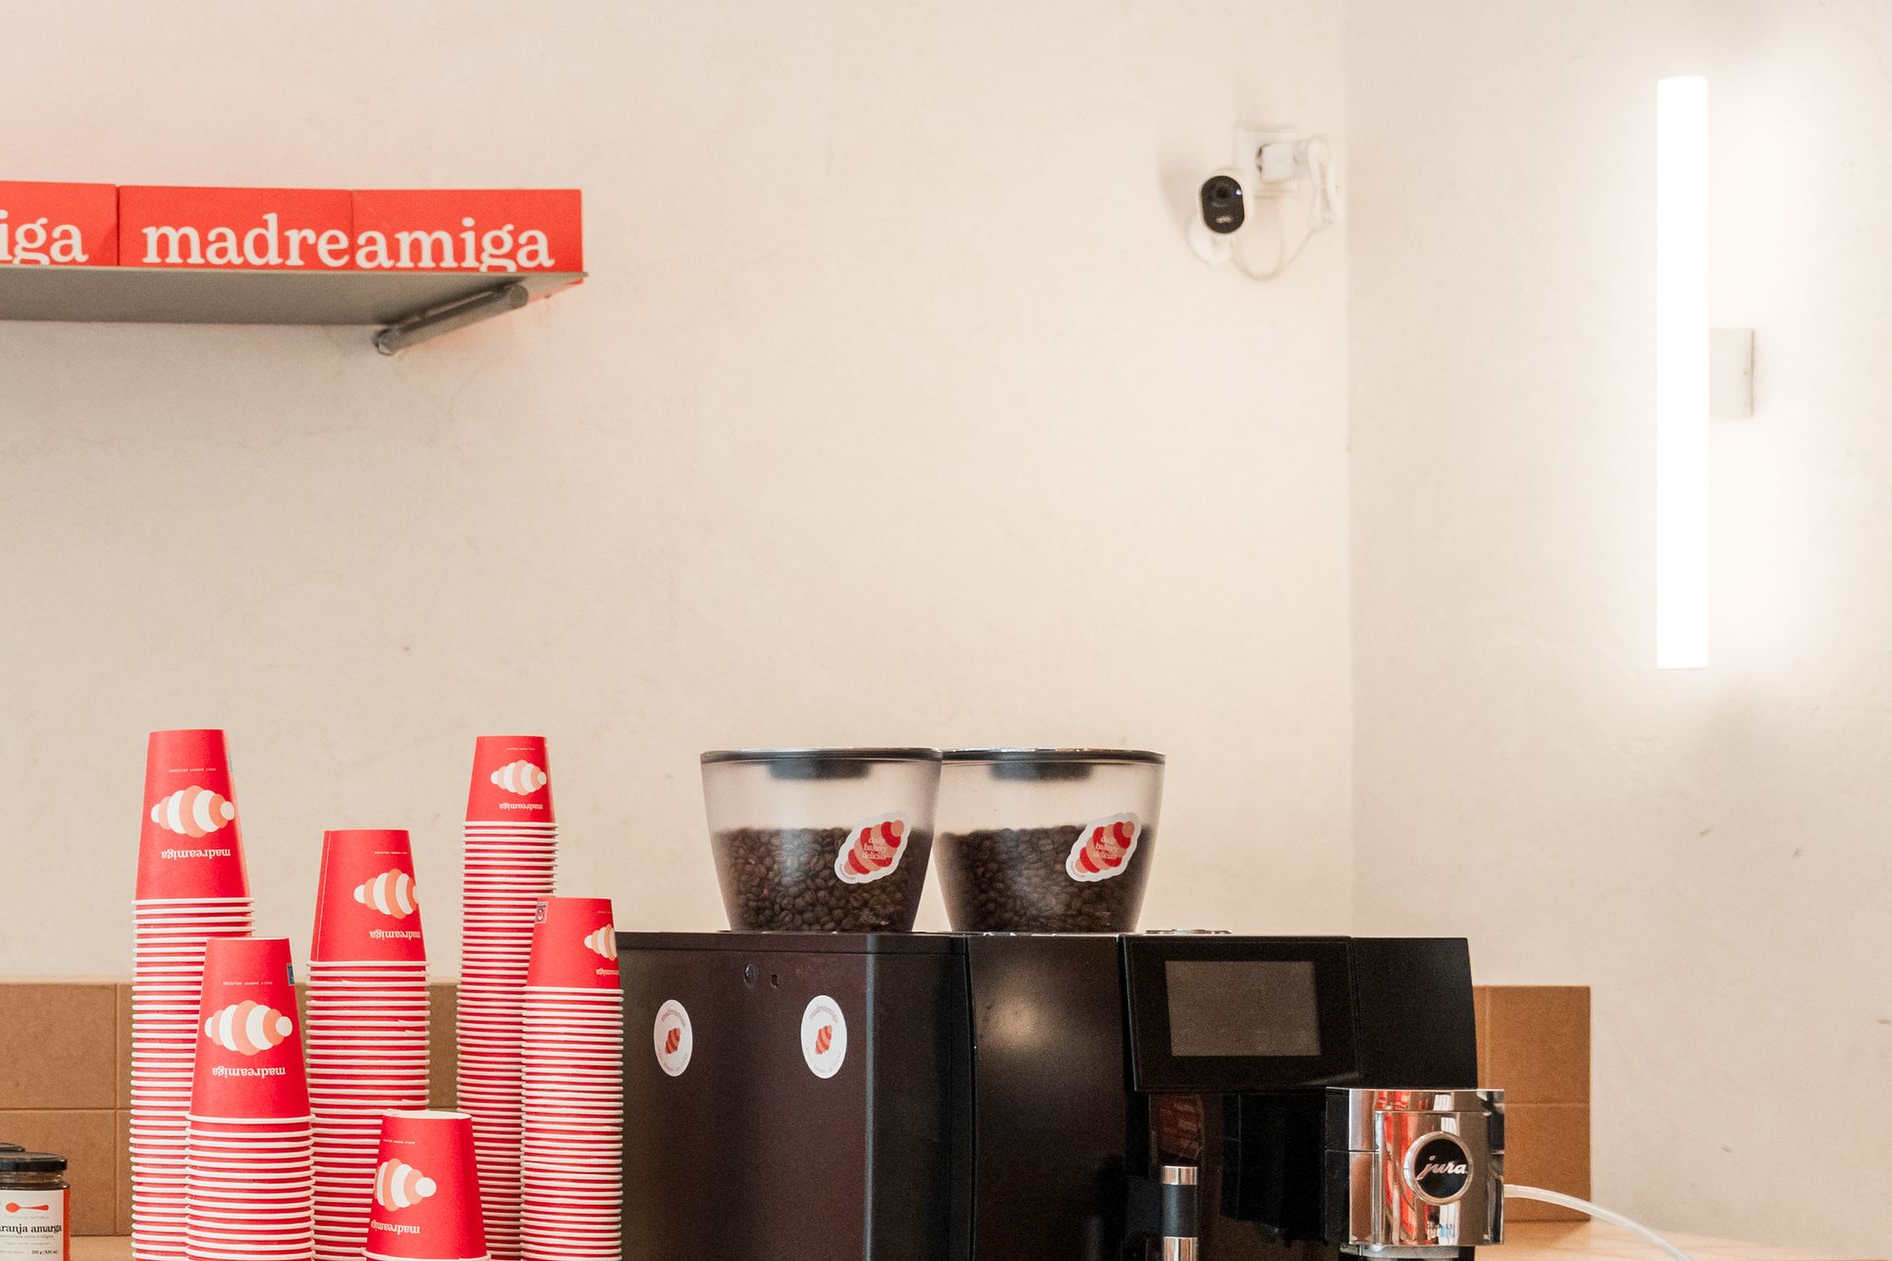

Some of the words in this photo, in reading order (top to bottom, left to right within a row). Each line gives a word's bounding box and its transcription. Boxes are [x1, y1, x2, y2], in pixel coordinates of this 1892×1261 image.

[161, 849, 231, 860] madreamiga
[213, 1065, 286, 1078] madreamiga
[1416, 1155, 1467, 1180] jura
[31, 1224, 62, 1233] amarga
